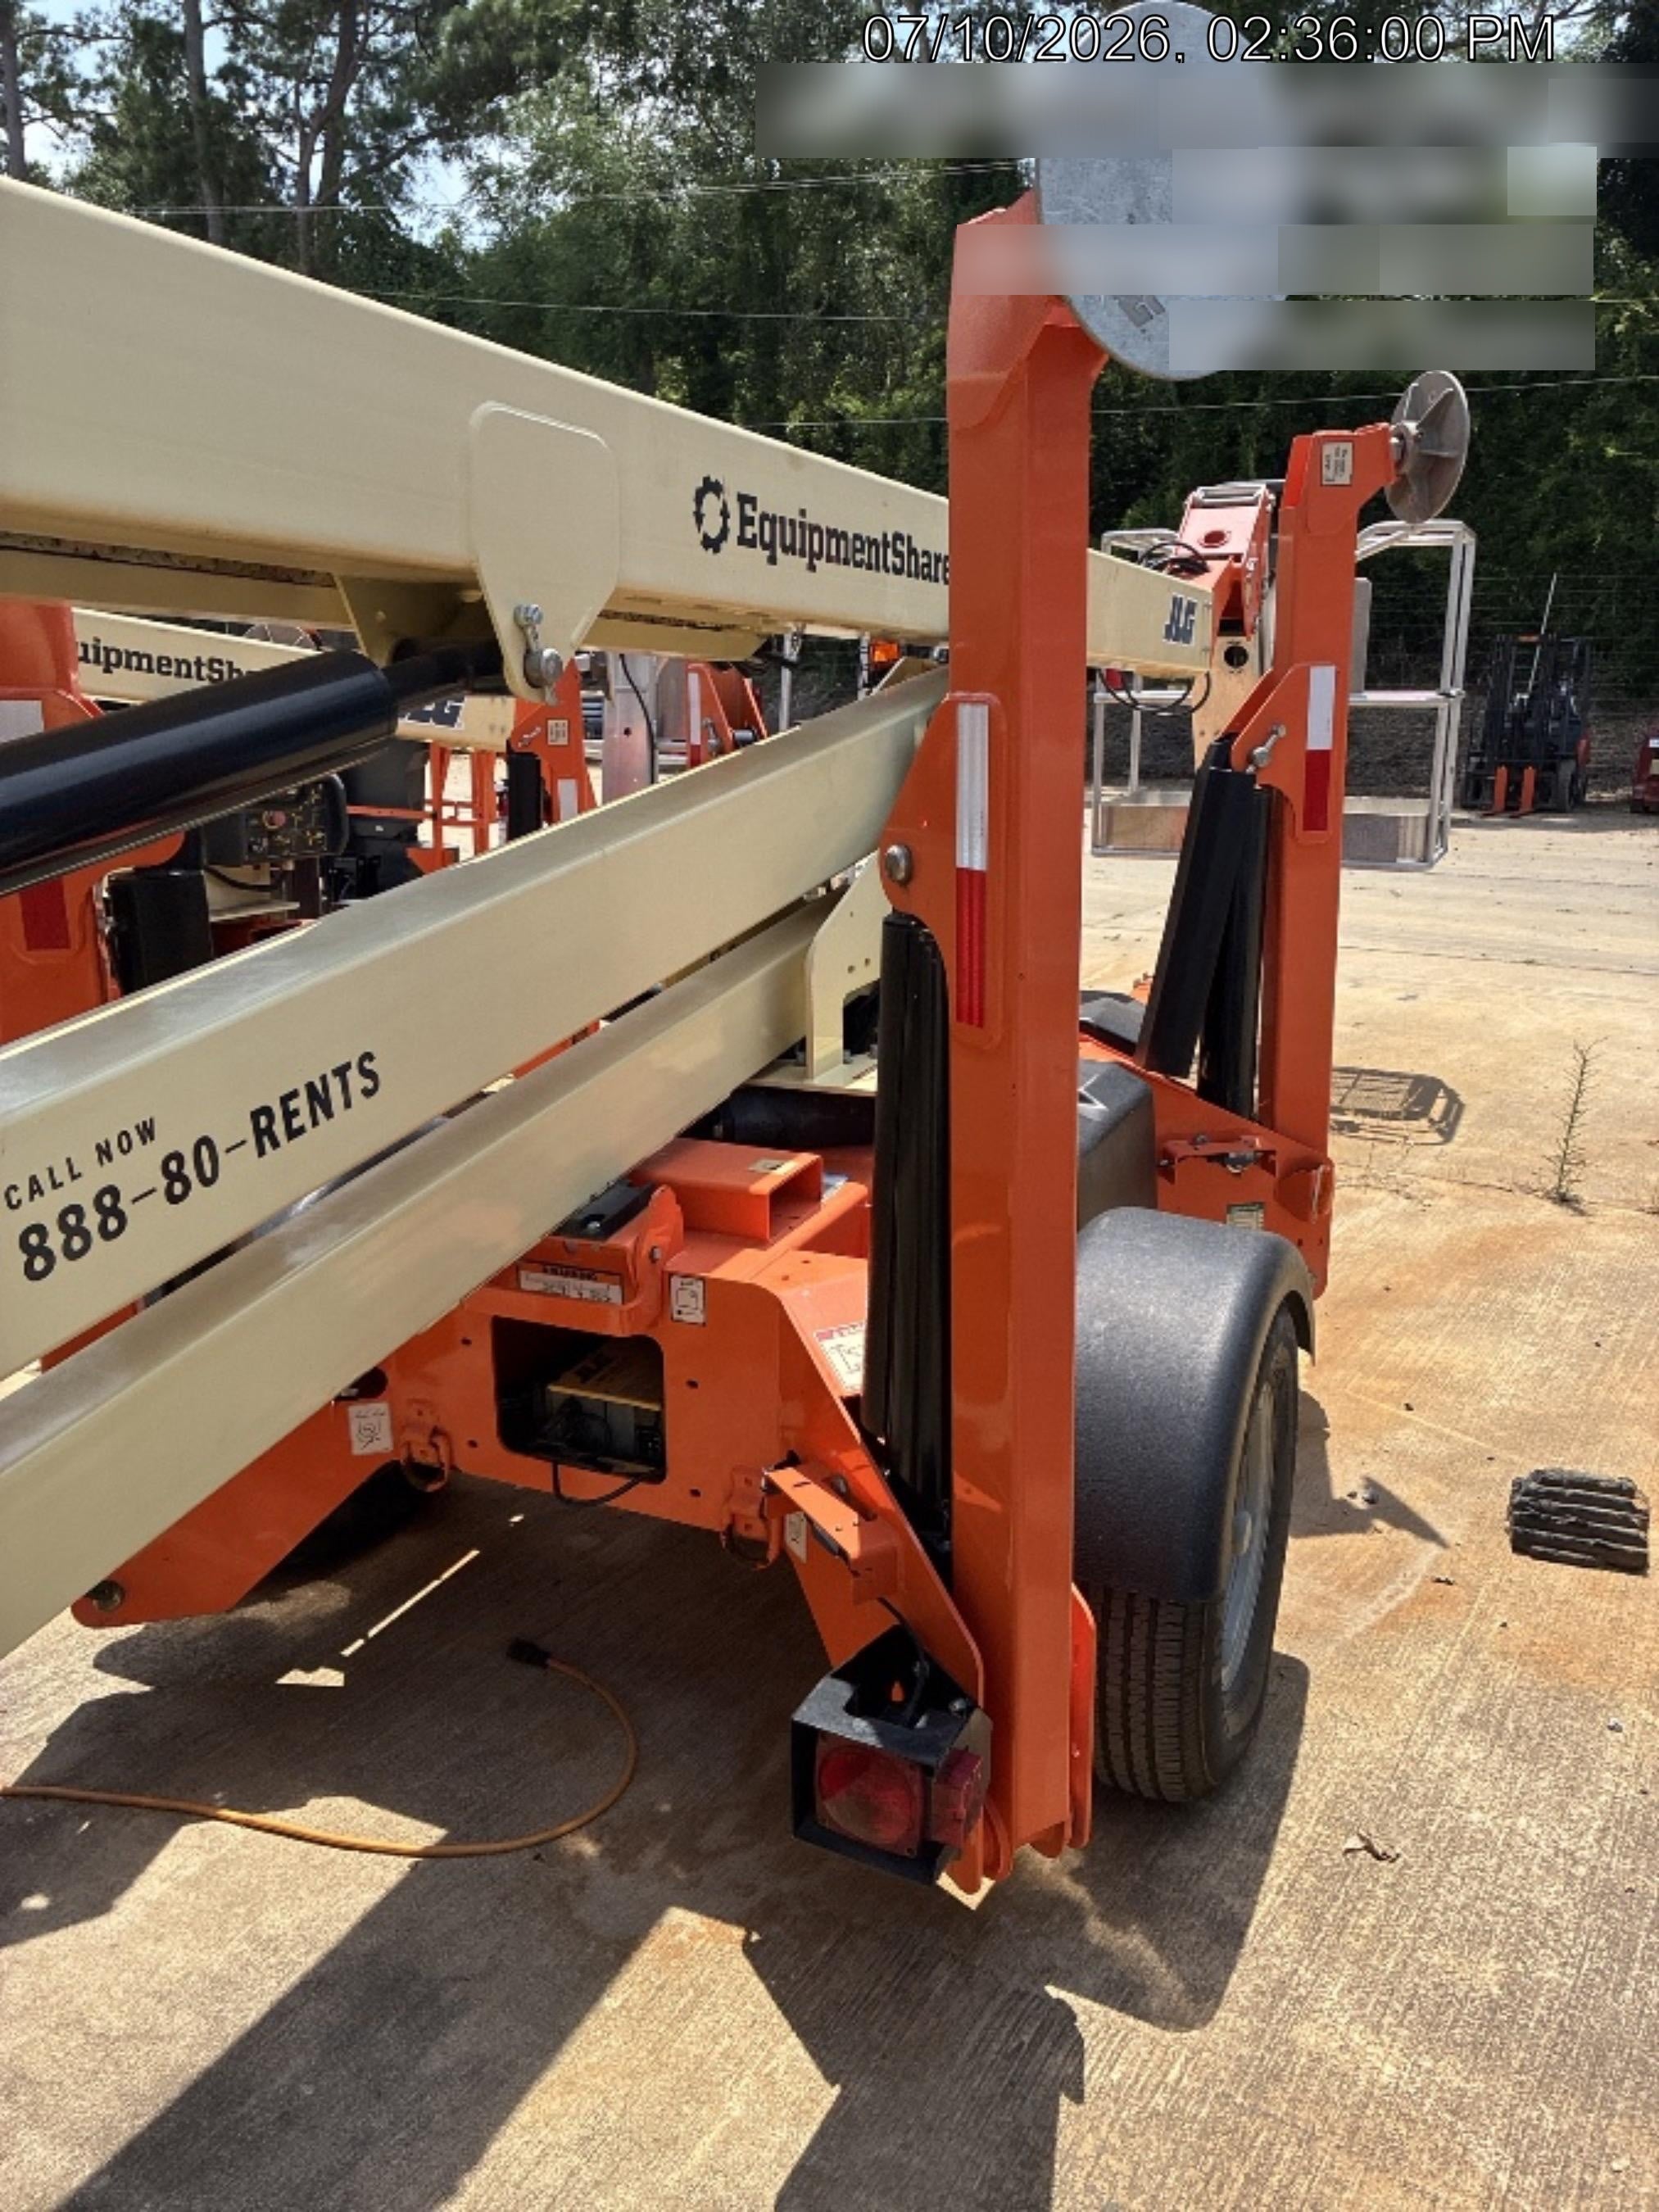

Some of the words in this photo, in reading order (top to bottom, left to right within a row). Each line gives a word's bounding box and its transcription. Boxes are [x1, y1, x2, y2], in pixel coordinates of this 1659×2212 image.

[1163, 595, 1197, 645] JLG
[75, 637, 244, 683] uipmentSh
[3, 1156, 83, 1210] CALL
[94, 1117, 156, 1167] NOW
[18, 1051, 381, 1281] 888-80-RENTS
